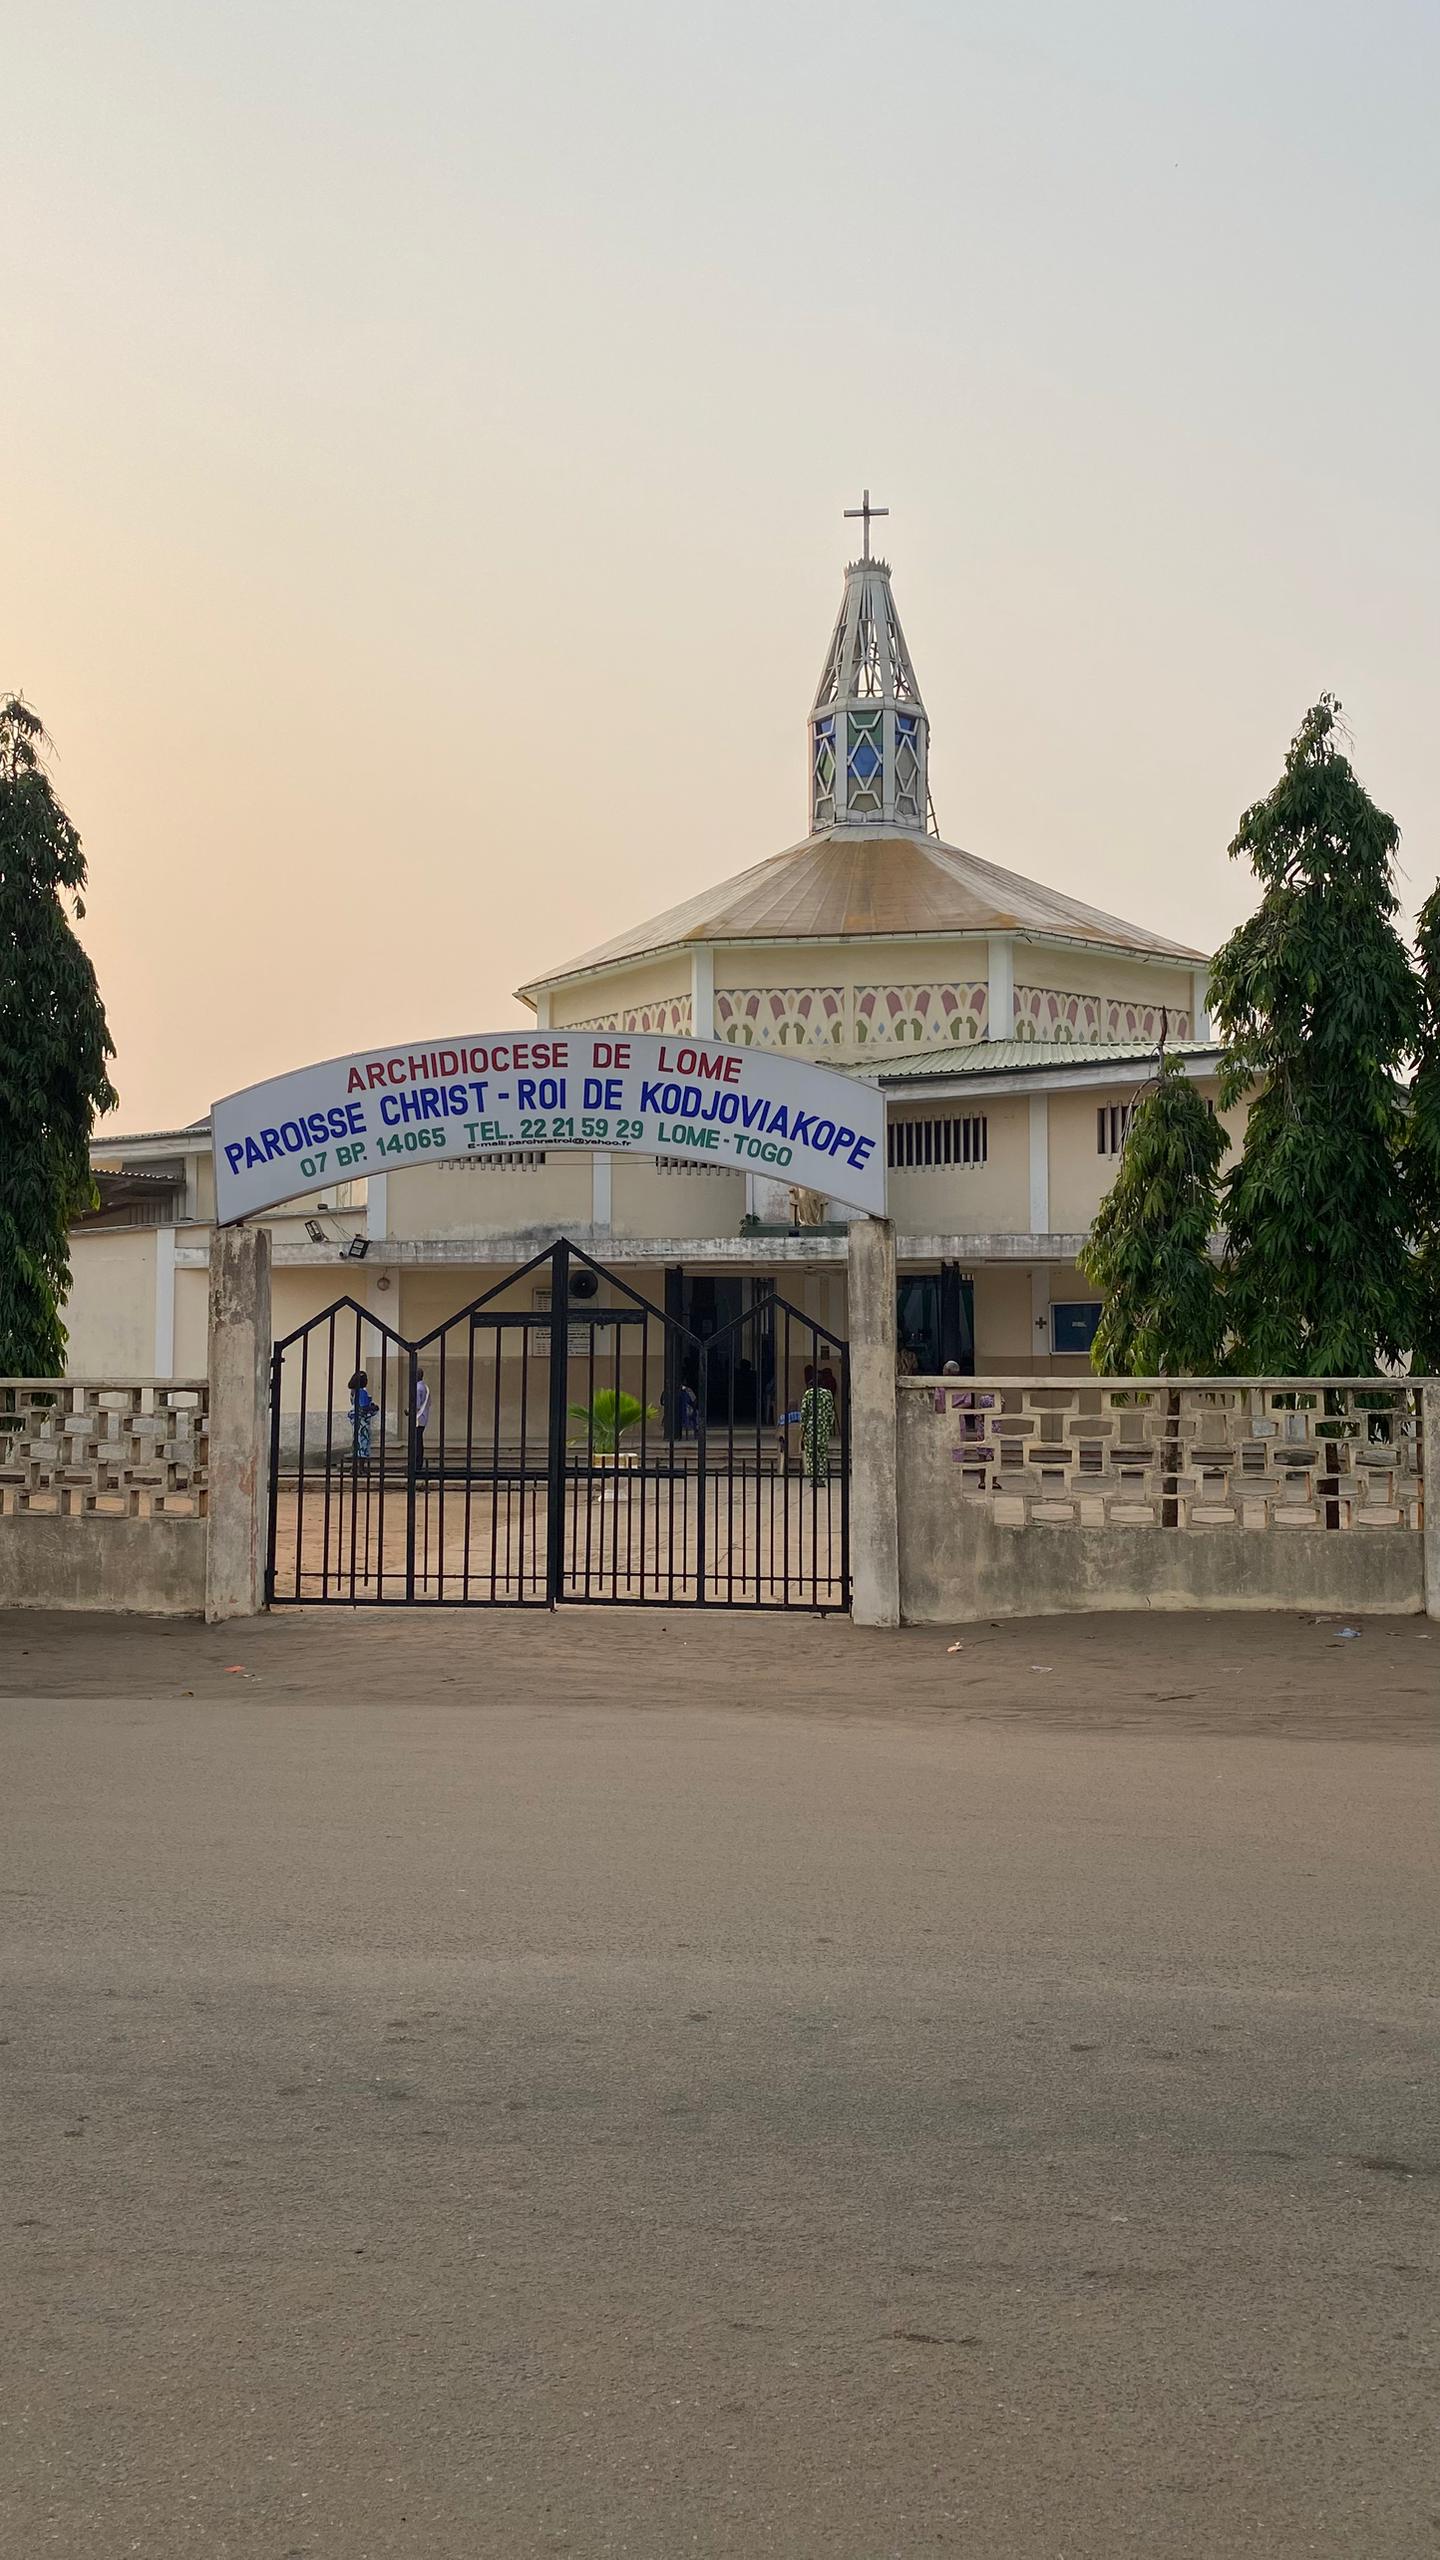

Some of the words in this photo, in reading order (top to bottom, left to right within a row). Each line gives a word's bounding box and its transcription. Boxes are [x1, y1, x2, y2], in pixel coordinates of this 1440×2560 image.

[347, 1043, 568, 1093] ARCHIDIOCESE
[593, 1043, 631, 1070] DE
[658, 1046, 743, 1083] LOME
[224, 1101, 367, 1175] PAROISSE
[583, 1078, 623, 1110] DE
[640, 1081, 876, 1170] KODJOVIAKOPE
[300, 1151, 328, 1178] 07
[335, 1141, 368, 1167] BP.
[376, 1126, 446, 1157] 14065
[464, 1120, 514, 1143] TEL.
